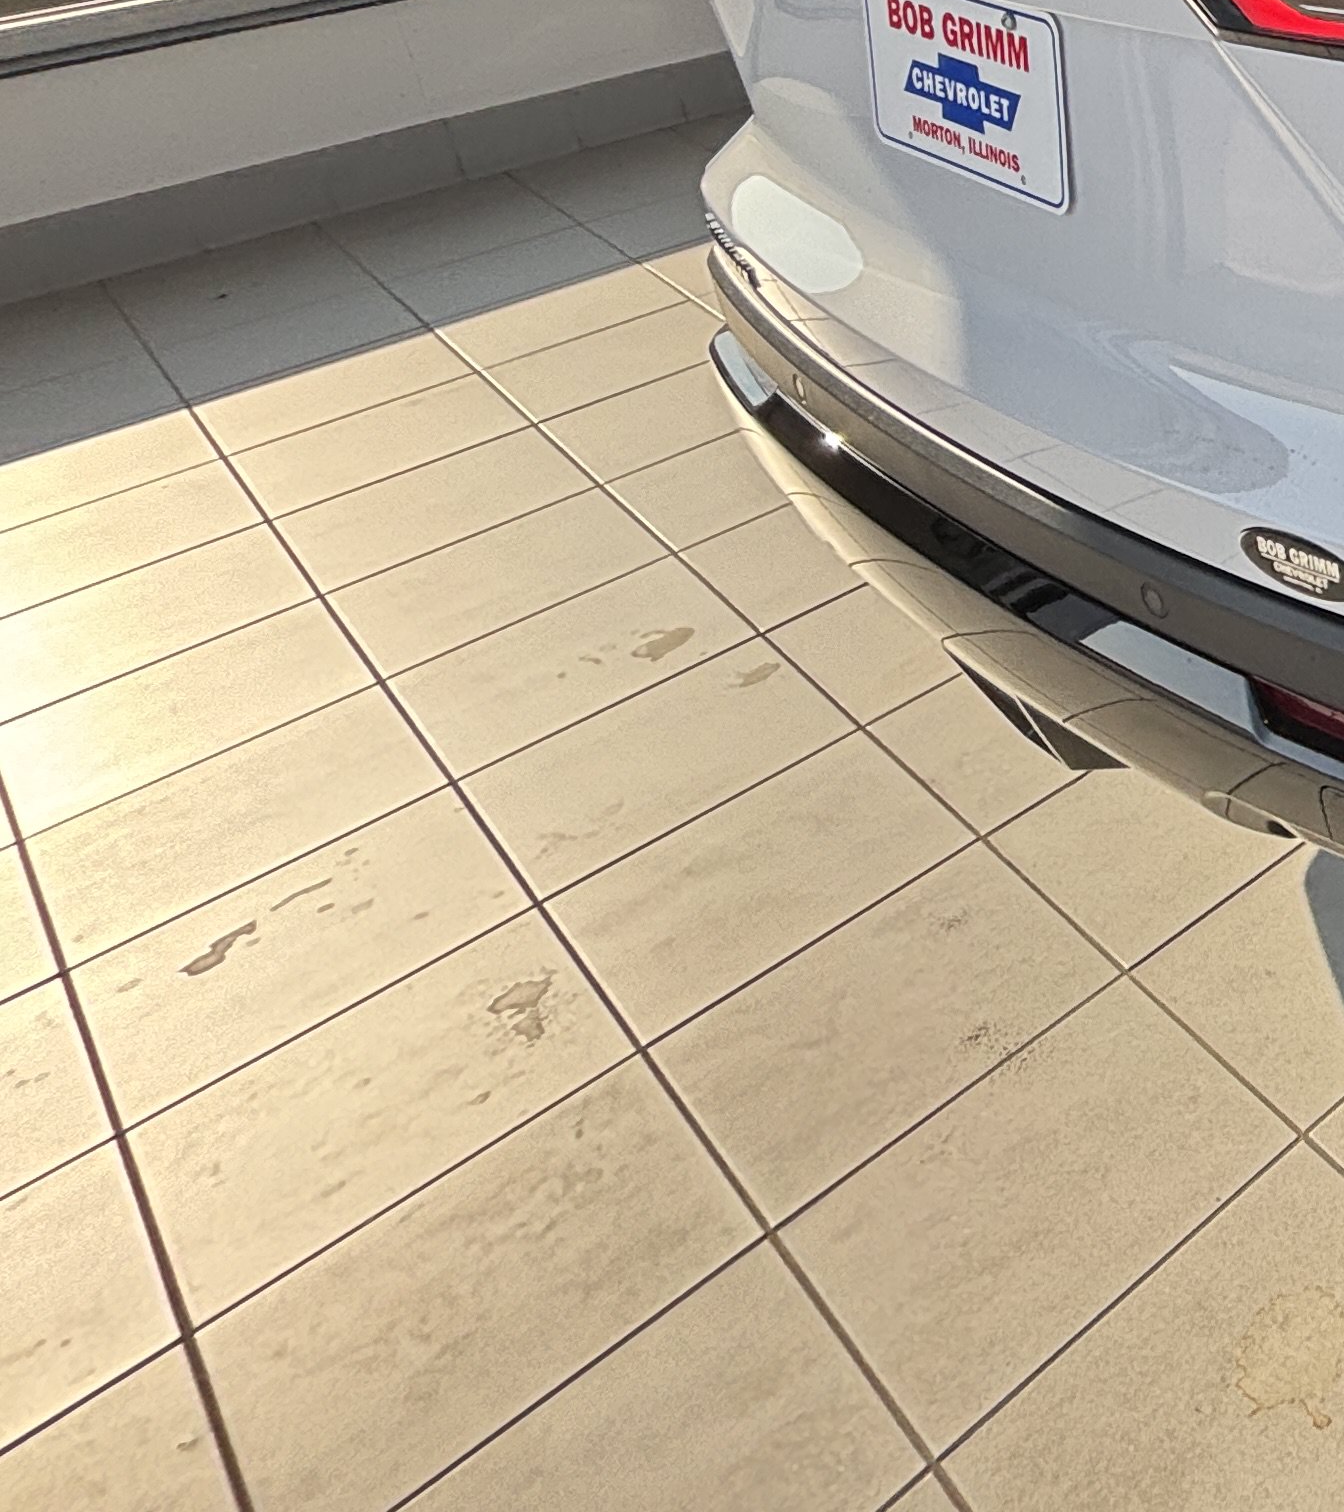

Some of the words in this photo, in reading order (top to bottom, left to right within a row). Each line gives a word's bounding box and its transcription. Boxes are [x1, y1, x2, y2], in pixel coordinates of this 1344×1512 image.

[942, 12, 1030, 73] GRIMM
[911, 67, 1010, 122] CHEVROLET
[912, 115, 966, 154] MORTON,
[968, 137, 1020, 173] ILLINOIS
[1256, 536, 1287, 560] BOB
[1289, 548, 1340, 578] GRIMM
[1273, 561, 1328, 589] CHEVROLET
